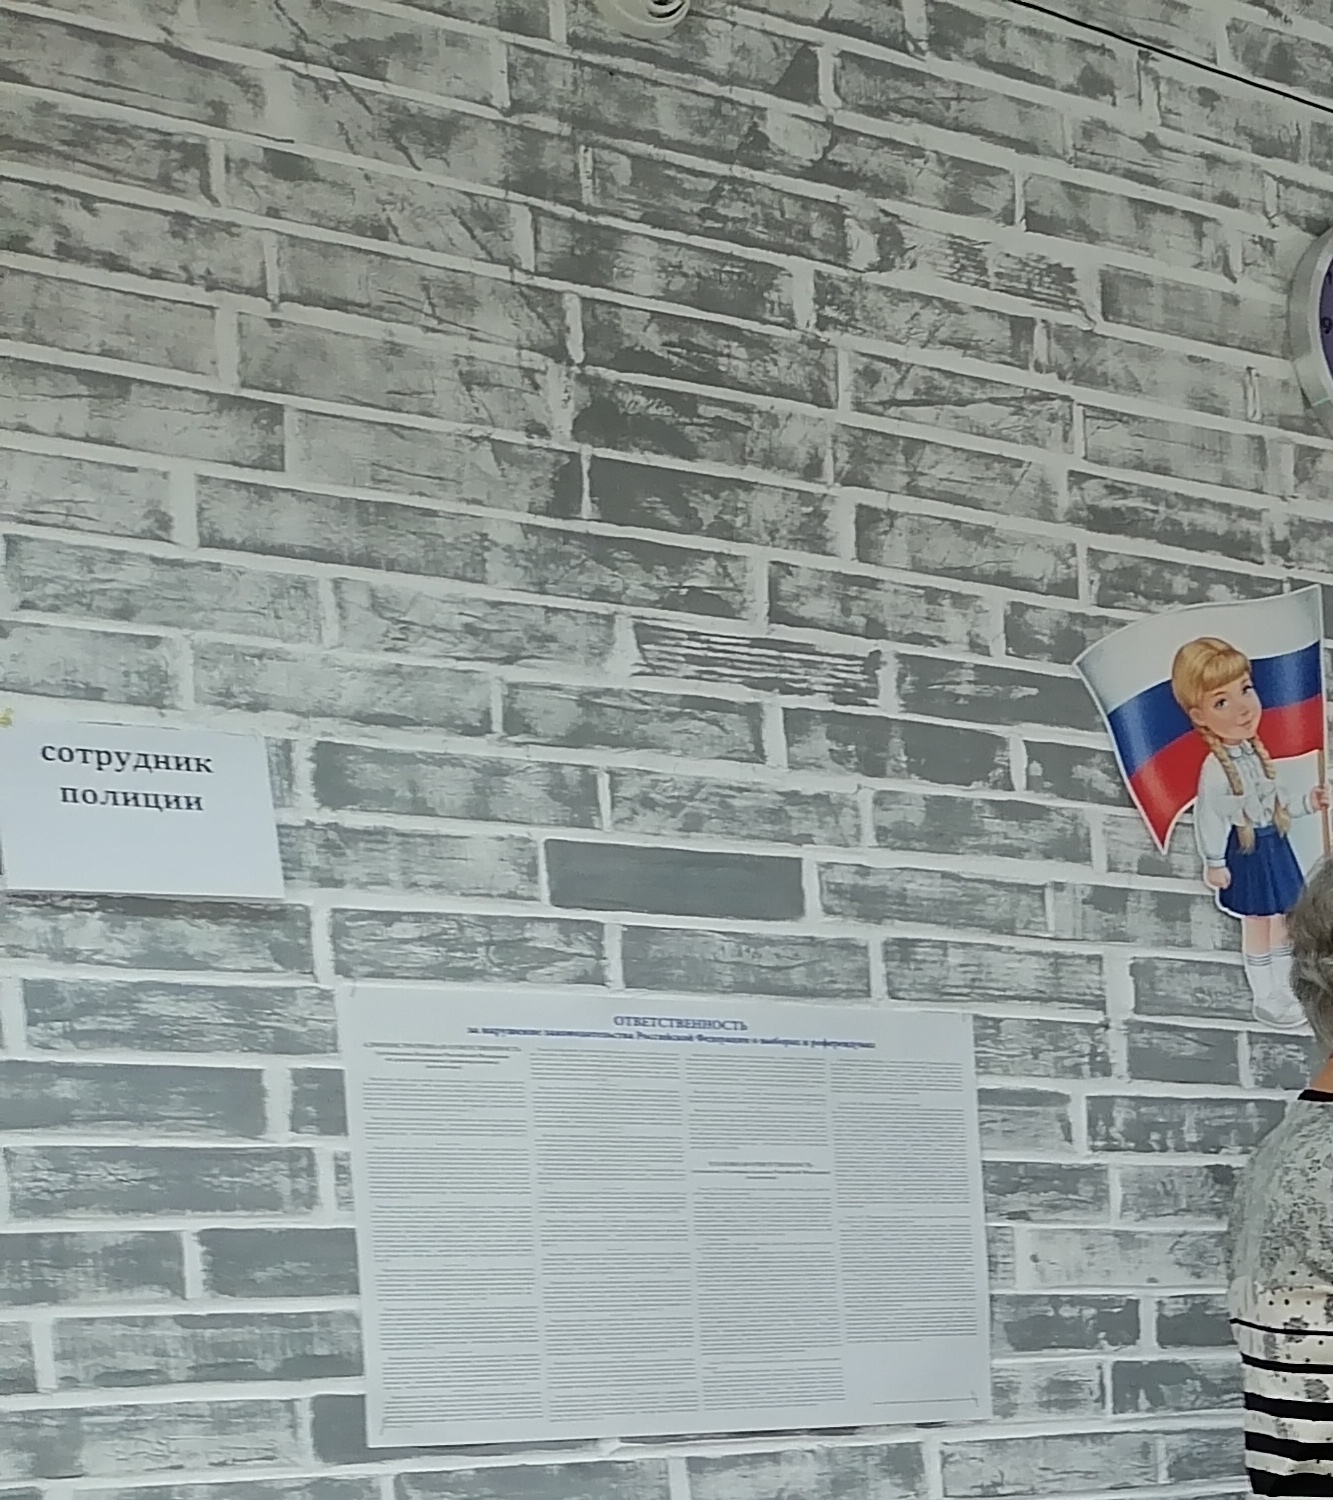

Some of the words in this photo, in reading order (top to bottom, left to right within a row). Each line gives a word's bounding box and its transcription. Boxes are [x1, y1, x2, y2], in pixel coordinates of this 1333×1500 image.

[1320, 316, 1333, 335] 9
[41, 744, 214, 774] сотрудник
[60, 786, 204, 812] полиции
[613, 1015, 749, 1031] ОТВЕТСТВЕННОСТЬ
